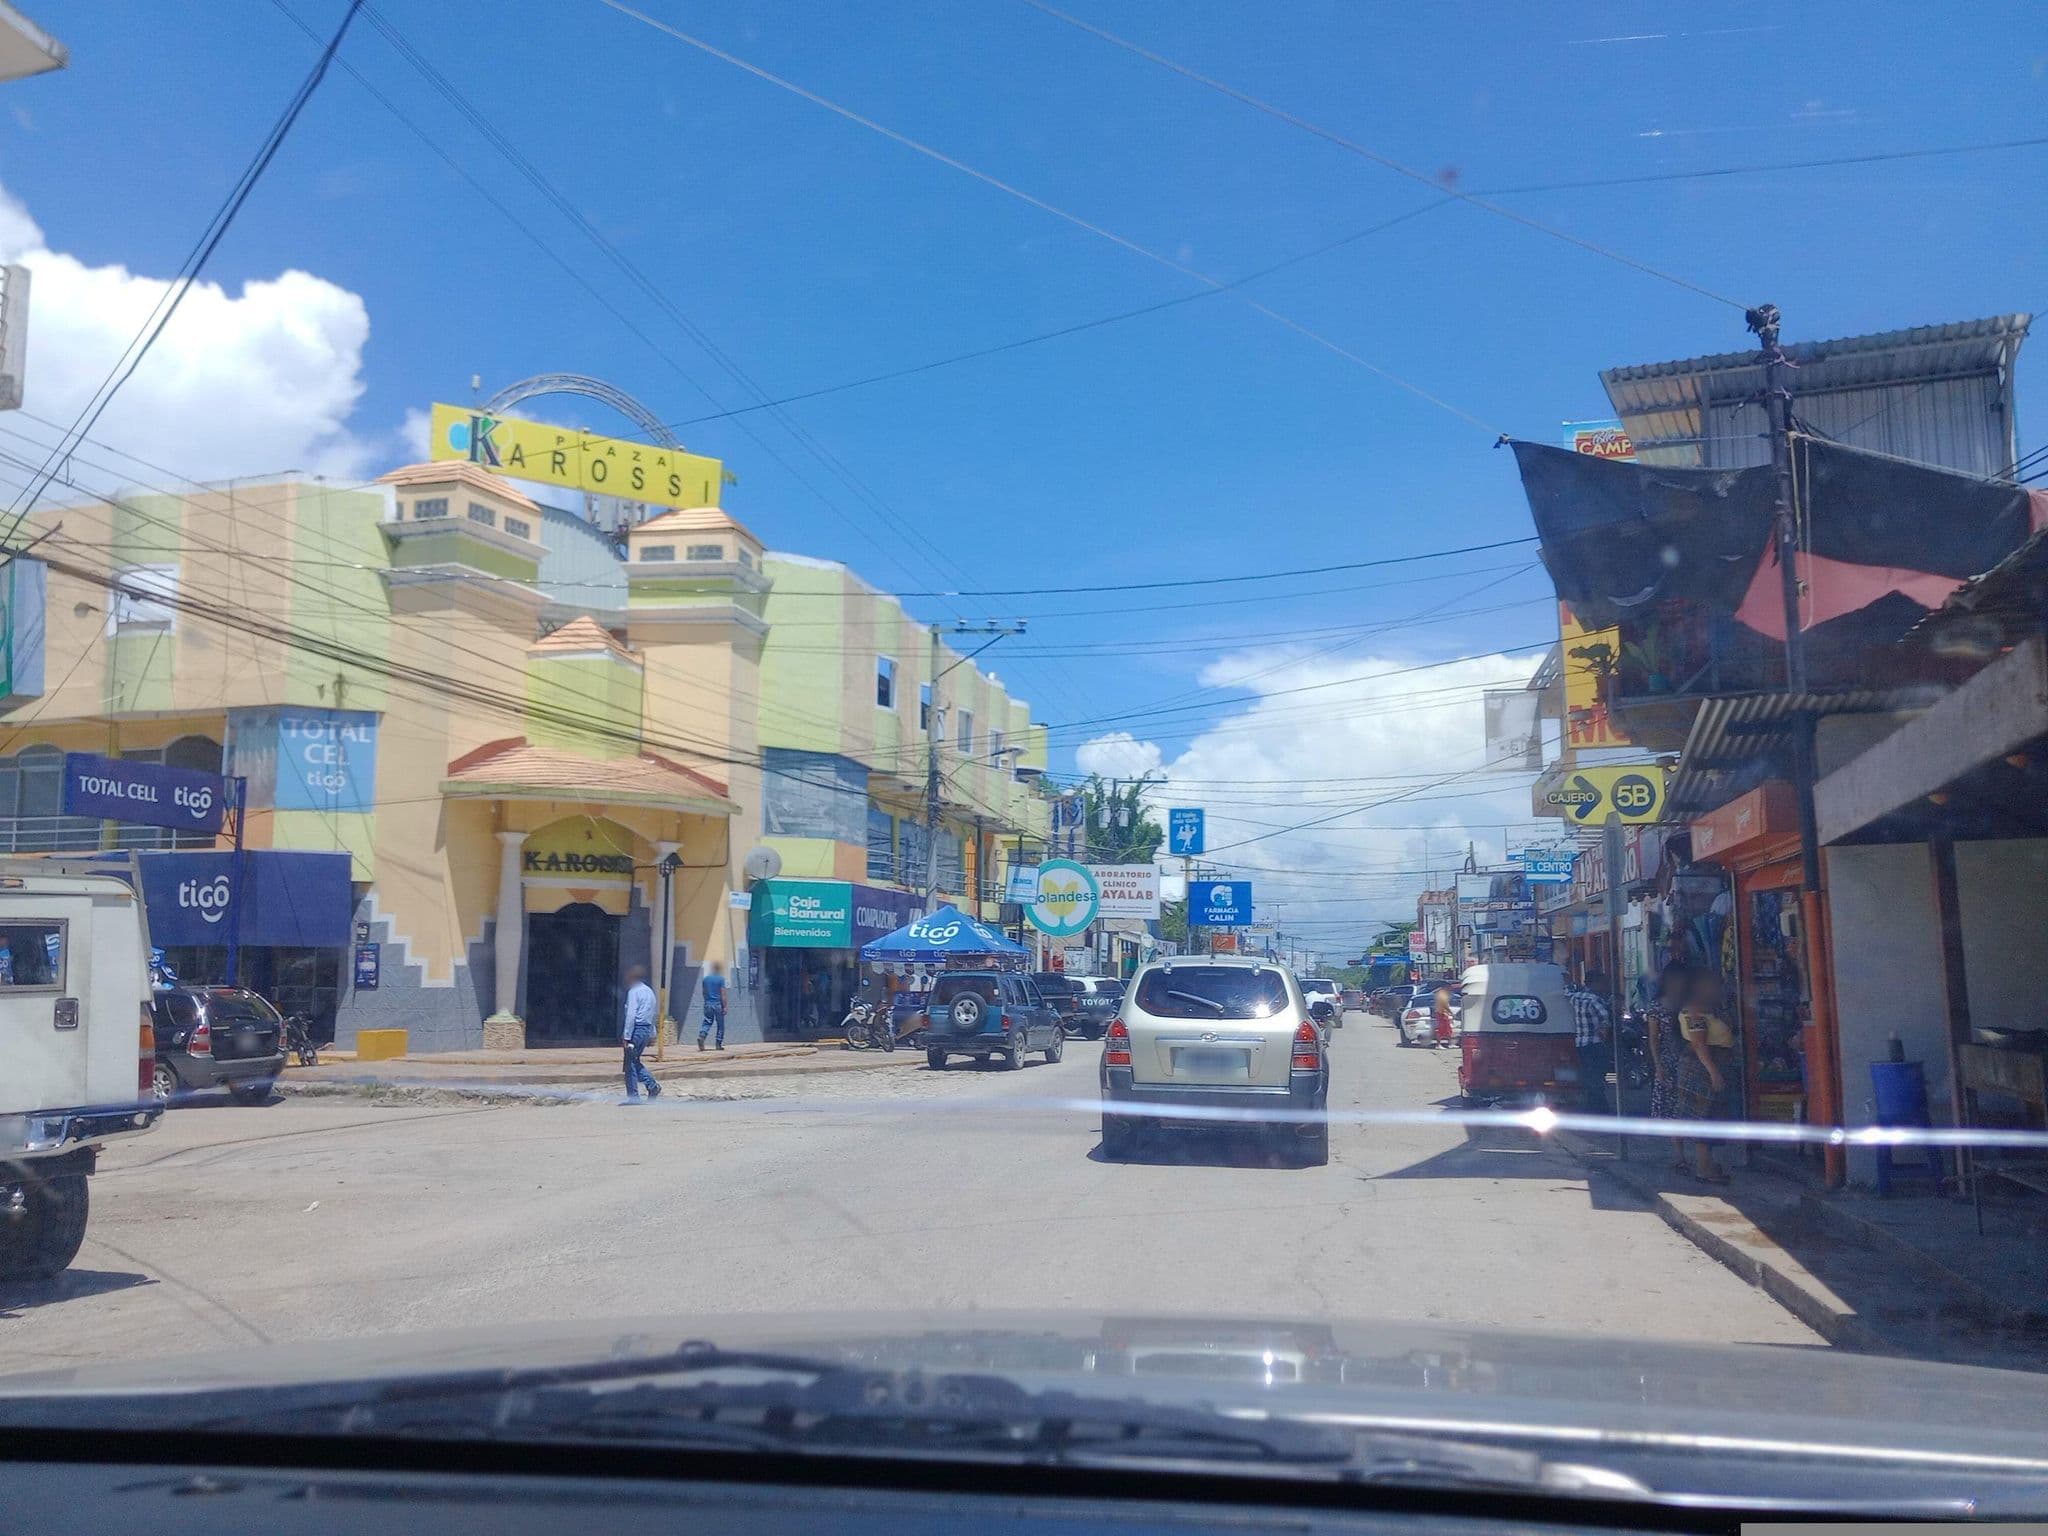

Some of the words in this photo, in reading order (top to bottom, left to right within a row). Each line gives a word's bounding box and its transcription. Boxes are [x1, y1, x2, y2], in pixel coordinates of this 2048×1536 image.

[555, 435, 667, 467] PLAZA
[1578, 439, 1632, 455] CAMP
[469, 414, 709, 504] KAROSSI
[287, 718, 372, 743] TOTAL
[307, 769, 346, 794] tigo
[79, 775, 125, 798] TOTAL
[127, 783, 158, 803] CELL
[174, 786, 212, 819] tigo
[1548, 791, 1595, 804] CAJERO
[1616, 784, 1650, 807] 5B
[1525, 861, 1536, 872] EL
[1537, 861, 1572, 872] CENTRO
[1094, 871, 1152, 879] ABORATORIO
[1103, 880, 1137, 888] CLINICO
[178, 875, 230, 923] tigo
[789, 895, 821, 909] Caja
[1038, 891, 1098, 904] olandesa
[1101, 889, 1153, 900] AYALAB
[789, 907, 845, 920] Banrural
[856, 906, 898, 930] COMPUZONE
[774, 926, 832, 938] Bienvenidos
[908, 921, 962, 945] tigo
